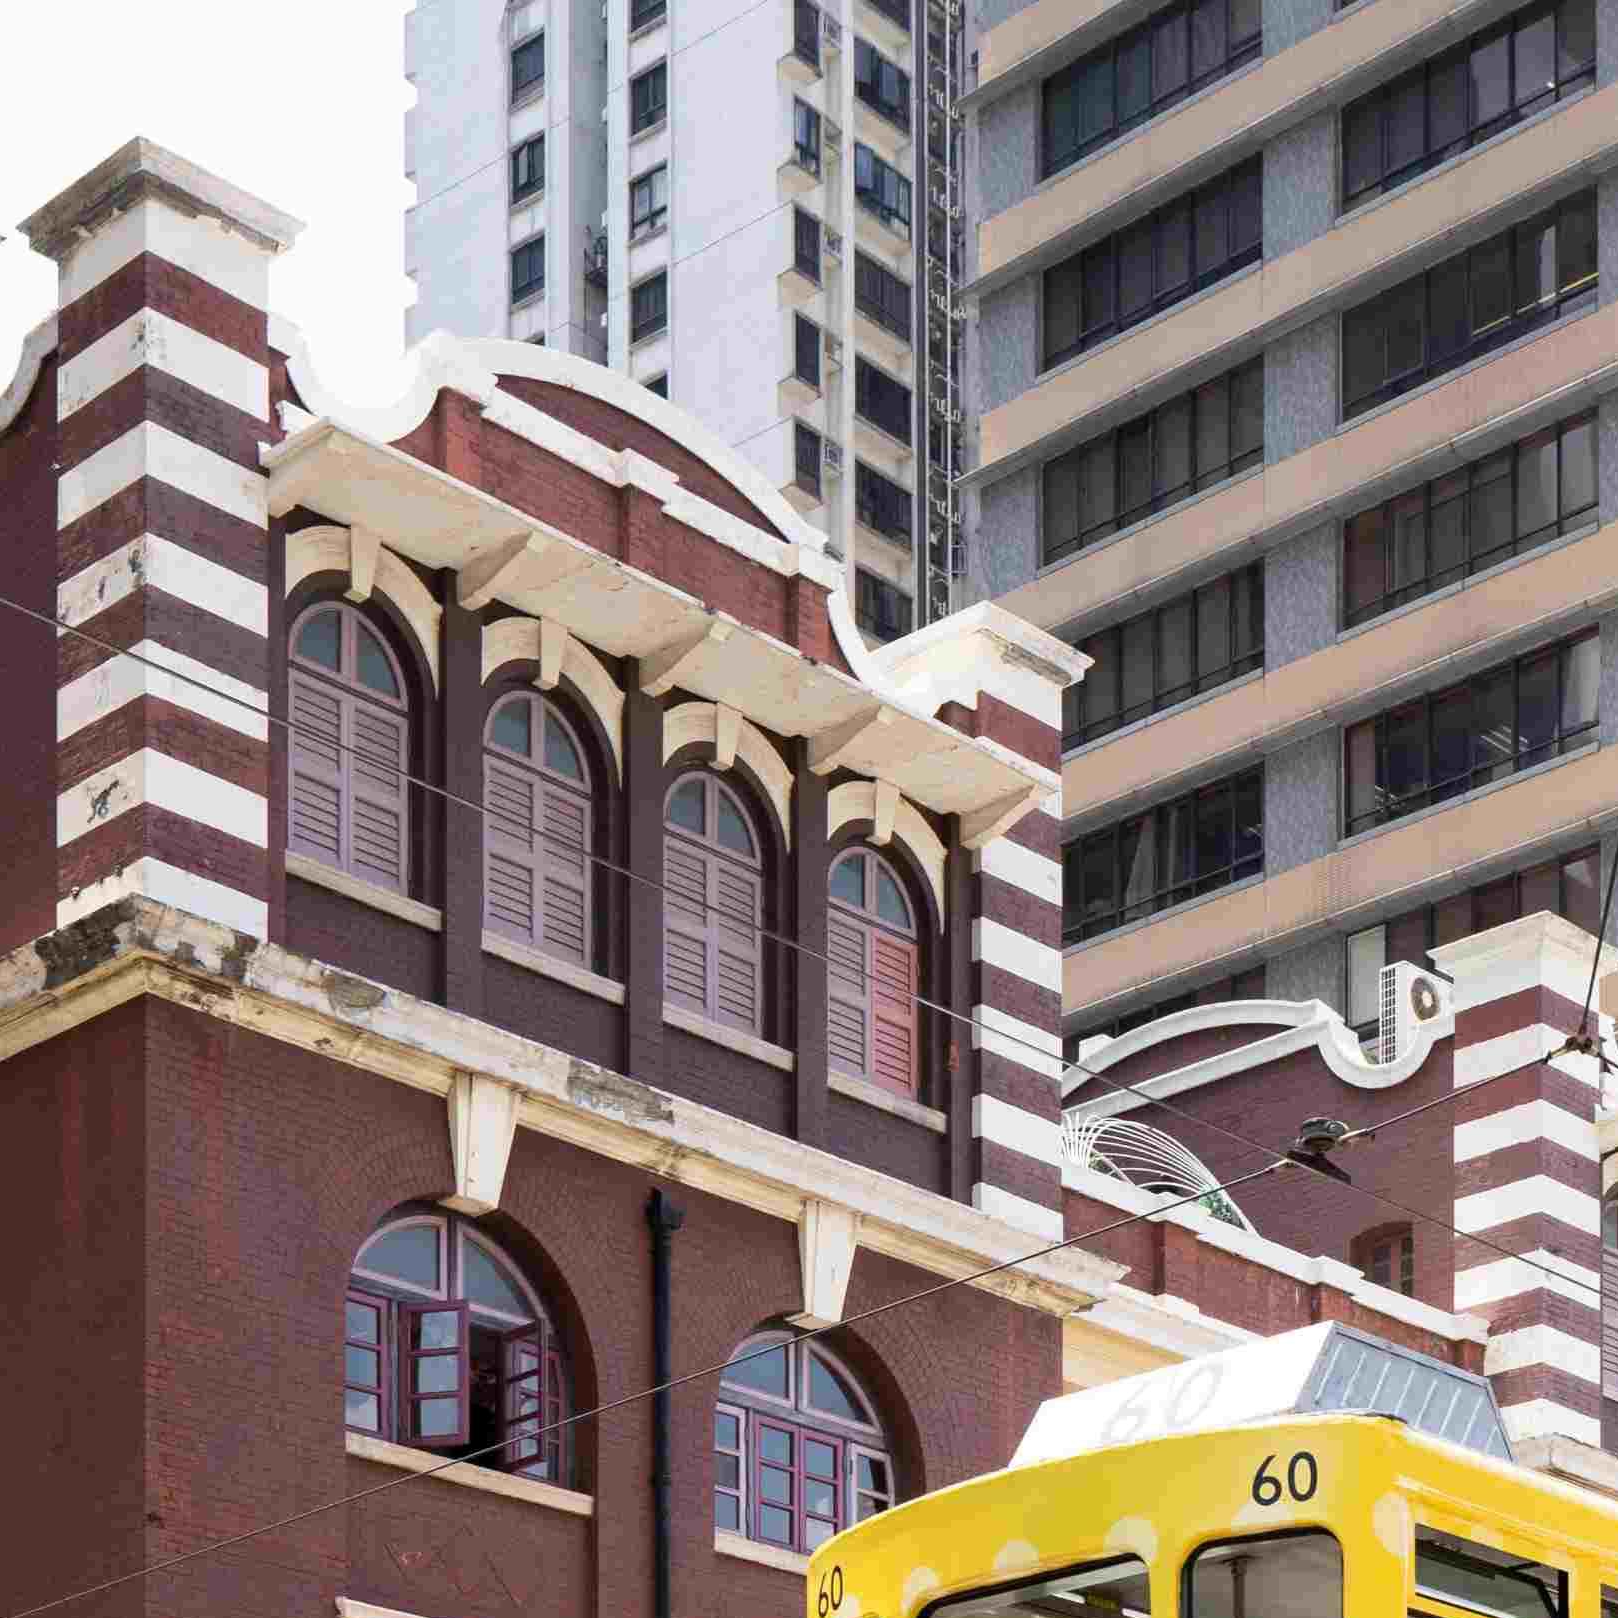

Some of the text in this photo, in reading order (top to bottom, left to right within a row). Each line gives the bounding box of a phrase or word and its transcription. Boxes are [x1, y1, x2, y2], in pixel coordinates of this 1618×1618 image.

[1100, 1361, 1223, 1441] 60
[1250, 1452, 1319, 1506] 60
[817, 1564, 845, 1618] 60
